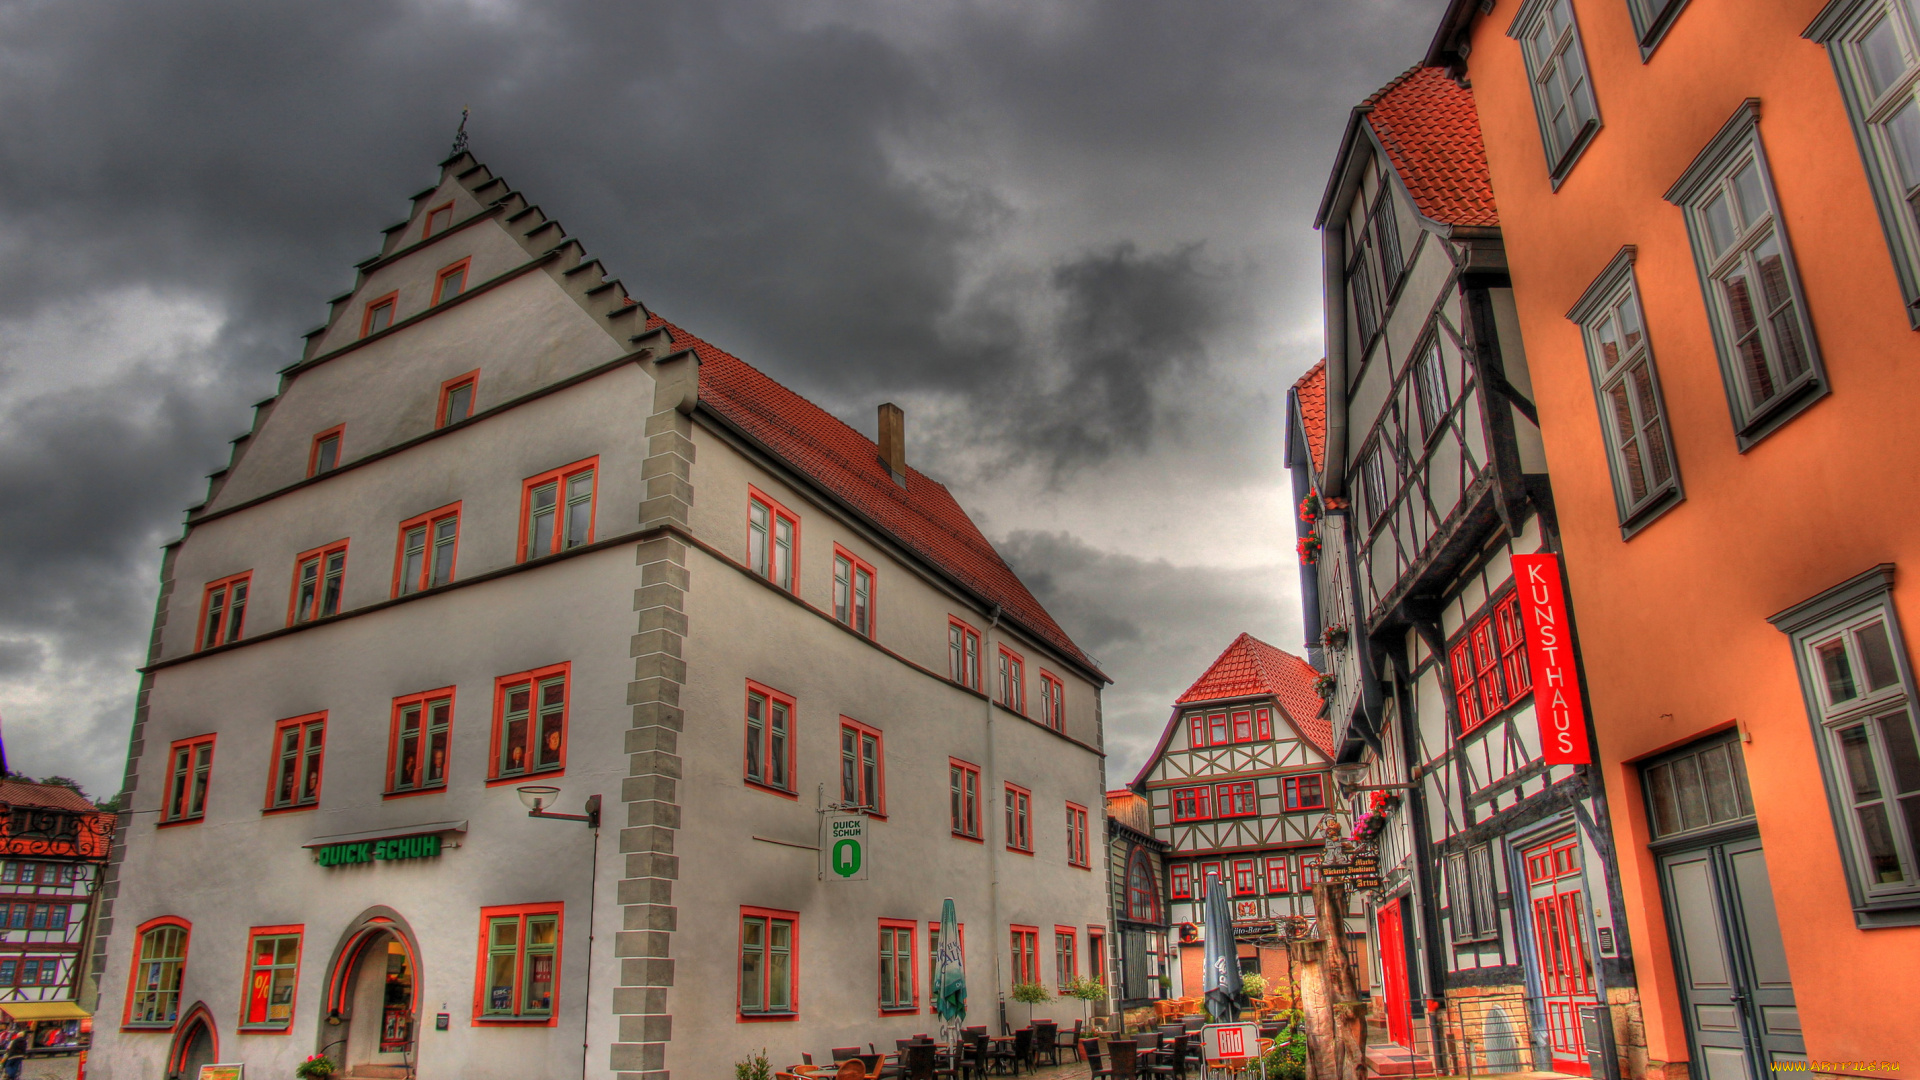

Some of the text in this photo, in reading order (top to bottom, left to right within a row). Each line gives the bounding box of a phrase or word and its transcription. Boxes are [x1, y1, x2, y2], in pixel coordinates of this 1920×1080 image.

[1527, 564, 1573, 753] KUNSTHAUS
[833, 821, 860, 829] QUICK
[833, 829, 861, 837] SCHUH
[319, 836, 438, 867] QUICK SCHUH
[832, 839, 861, 877] Q
[1356, 879, 1379, 887] Artus
[1219, 1030, 1243, 1053] Bild
